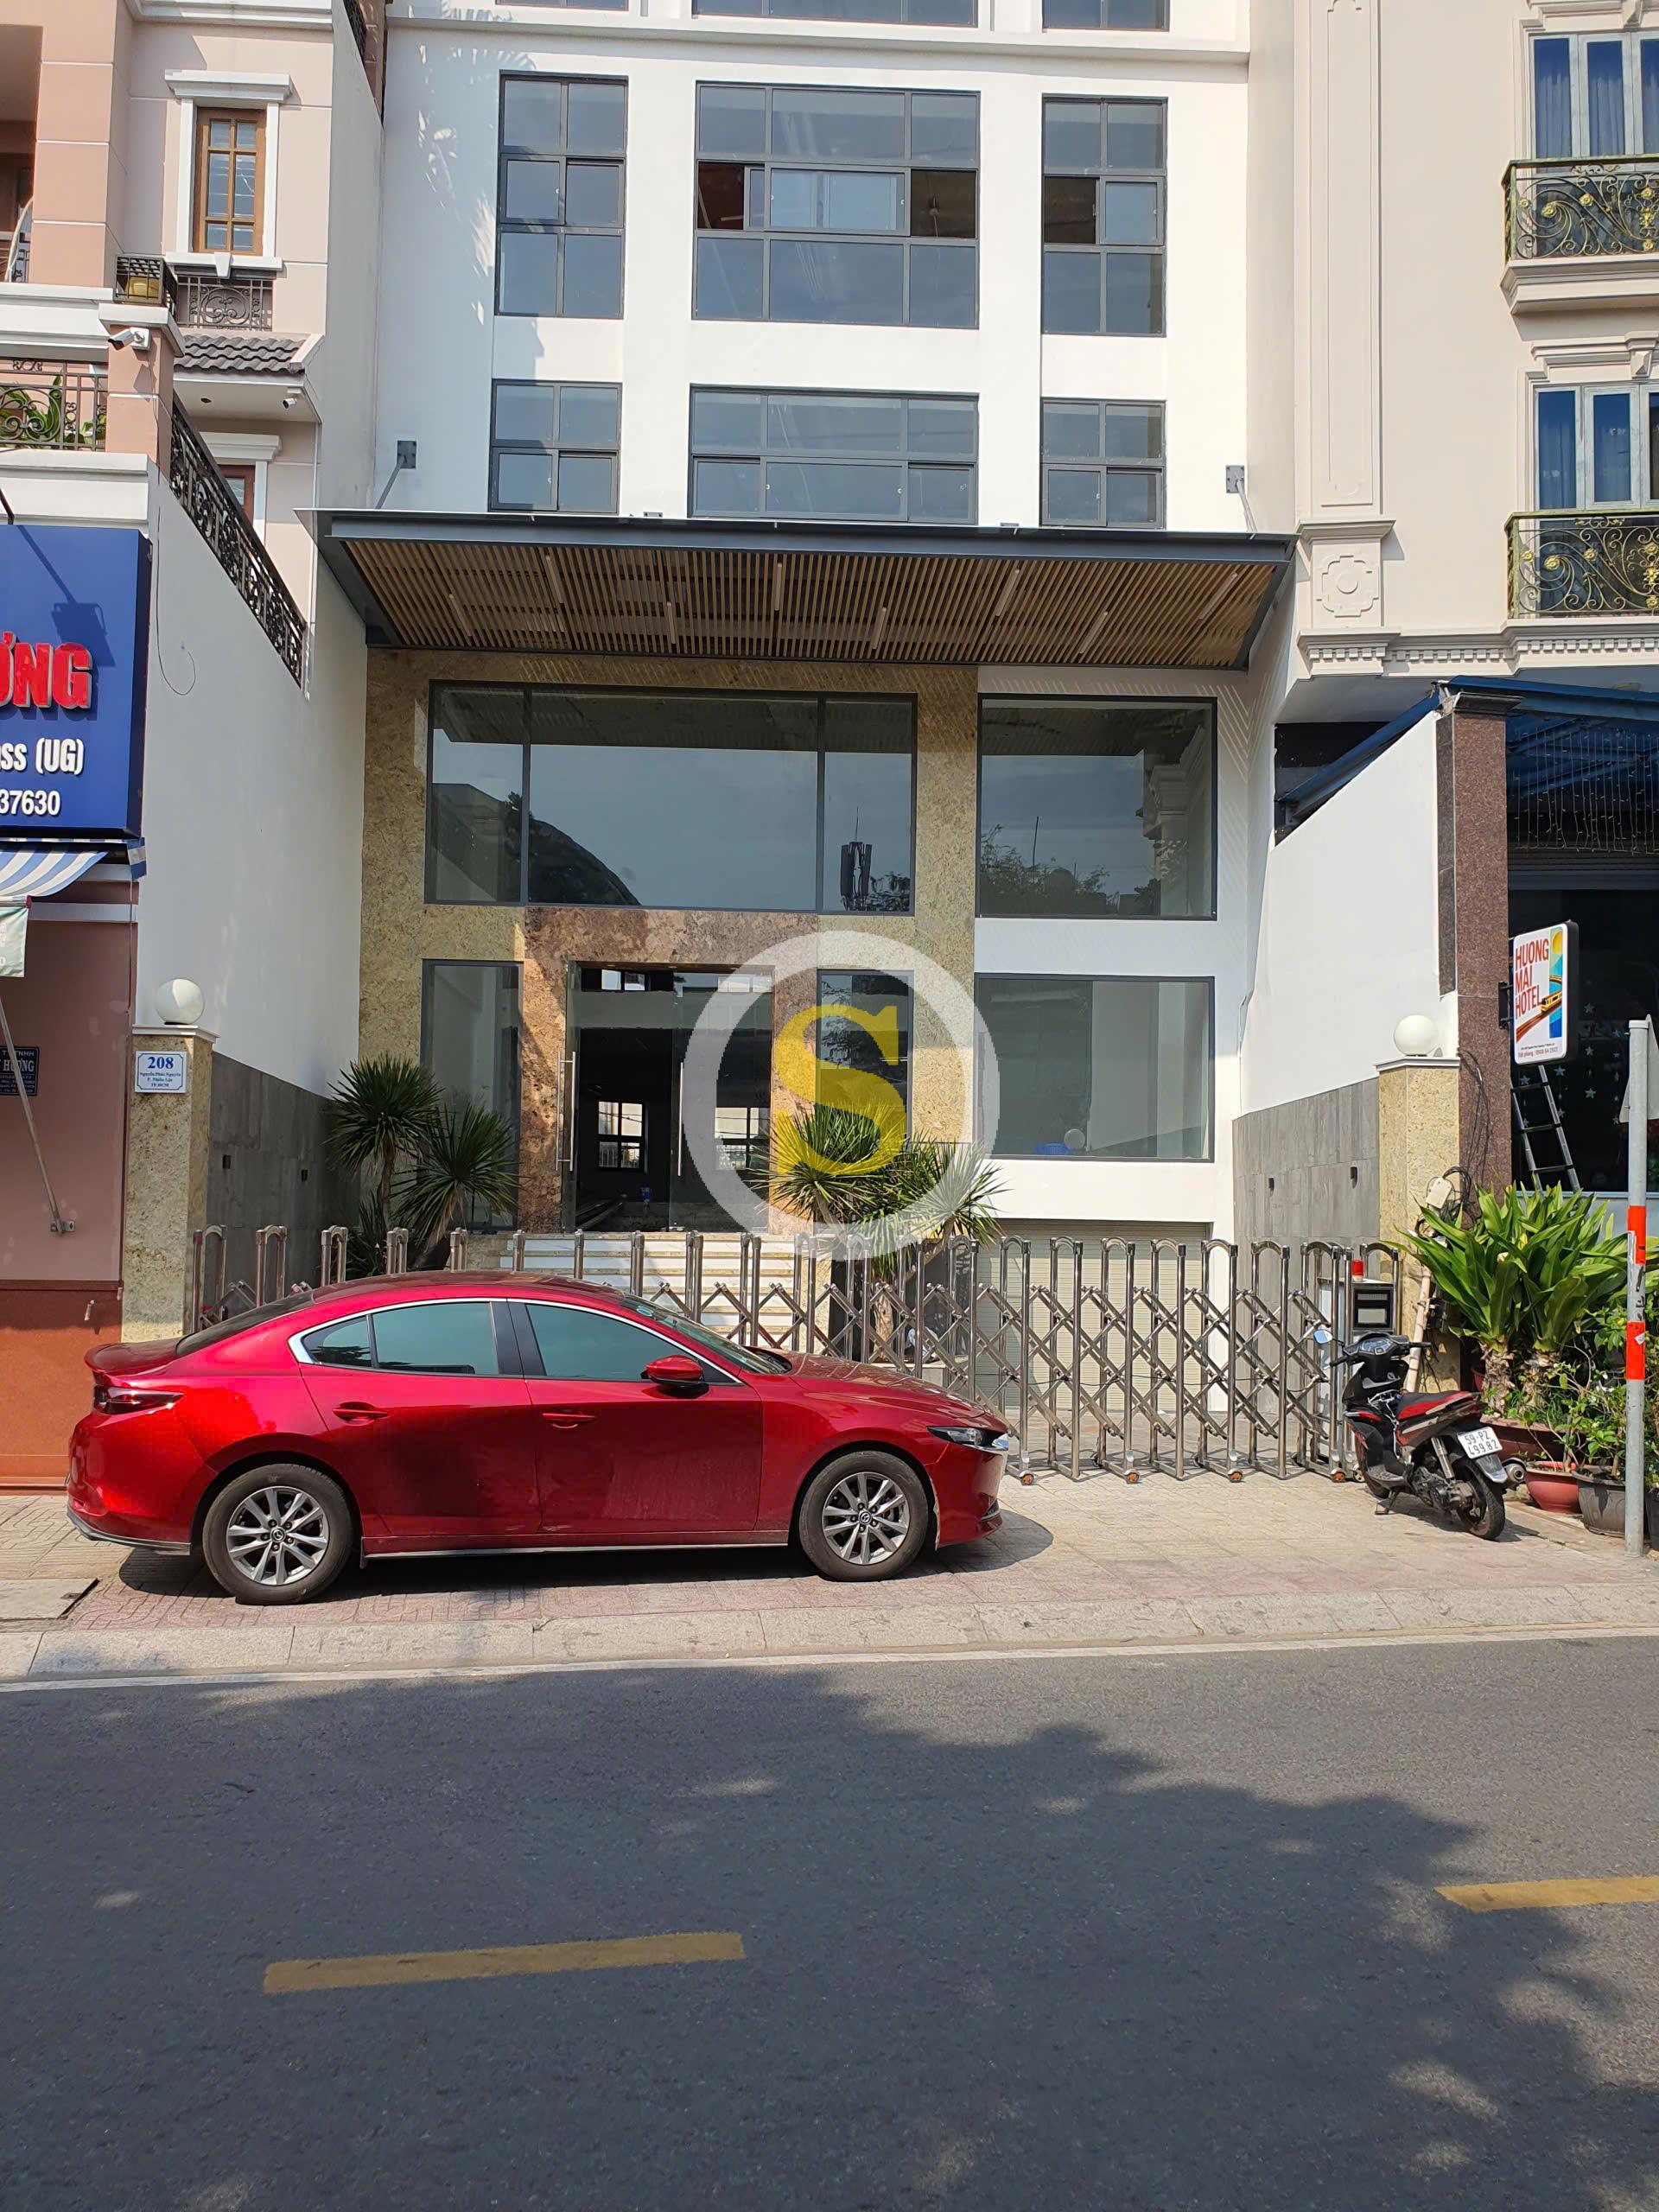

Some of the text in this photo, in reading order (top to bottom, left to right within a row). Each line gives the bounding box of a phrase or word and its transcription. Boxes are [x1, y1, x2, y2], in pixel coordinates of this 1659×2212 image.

[35, 738, 85, 775] (UG)
[0, 788, 60, 816] 37630
[1516, 939, 1549, 971] HUONG
[1516, 967, 1533, 992] MAI
[1516, 985, 1542, 1020] HOTEL
[148, 1056, 174, 1069] 208
[1465, 1431, 1491, 1445] 59-P2
